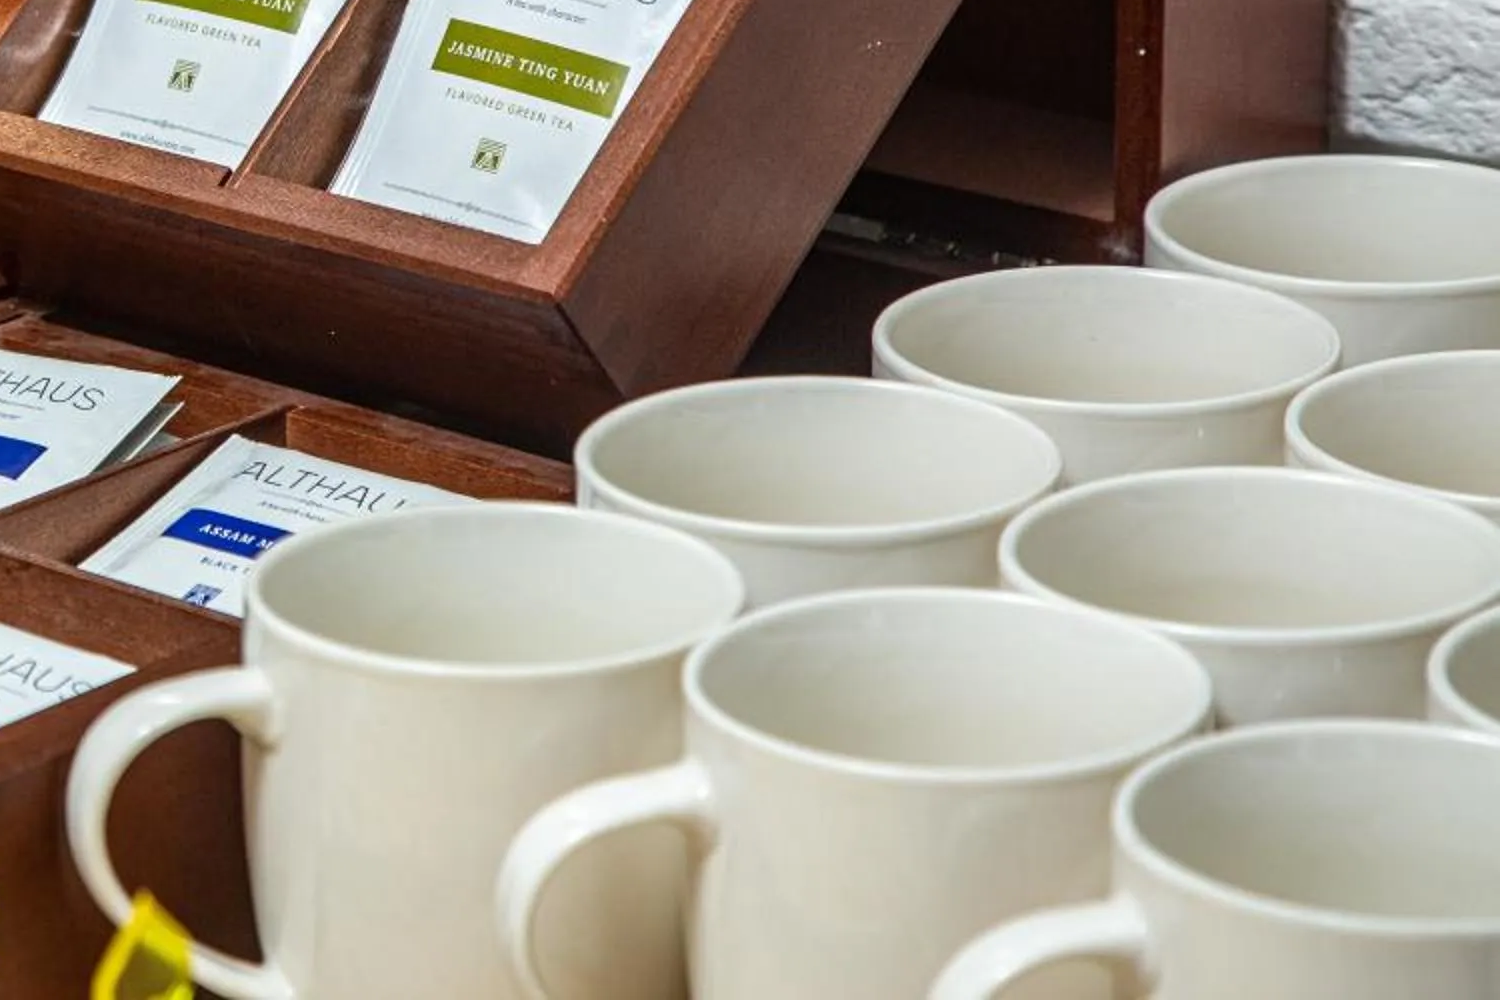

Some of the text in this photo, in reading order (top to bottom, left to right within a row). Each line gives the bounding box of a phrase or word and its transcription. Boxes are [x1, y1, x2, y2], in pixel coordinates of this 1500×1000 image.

[145, 12, 262, 49] FLAVORED GREEN TEA
[447, 39, 611, 96] JASMINE TING YUAN
[445, 86, 574, 132] FLAVORED GREEN TEA
[231, 461, 405, 513] ALTHAU
[199, 523, 257, 545] ASSAM
[200, 556, 239, 571] BLACK
